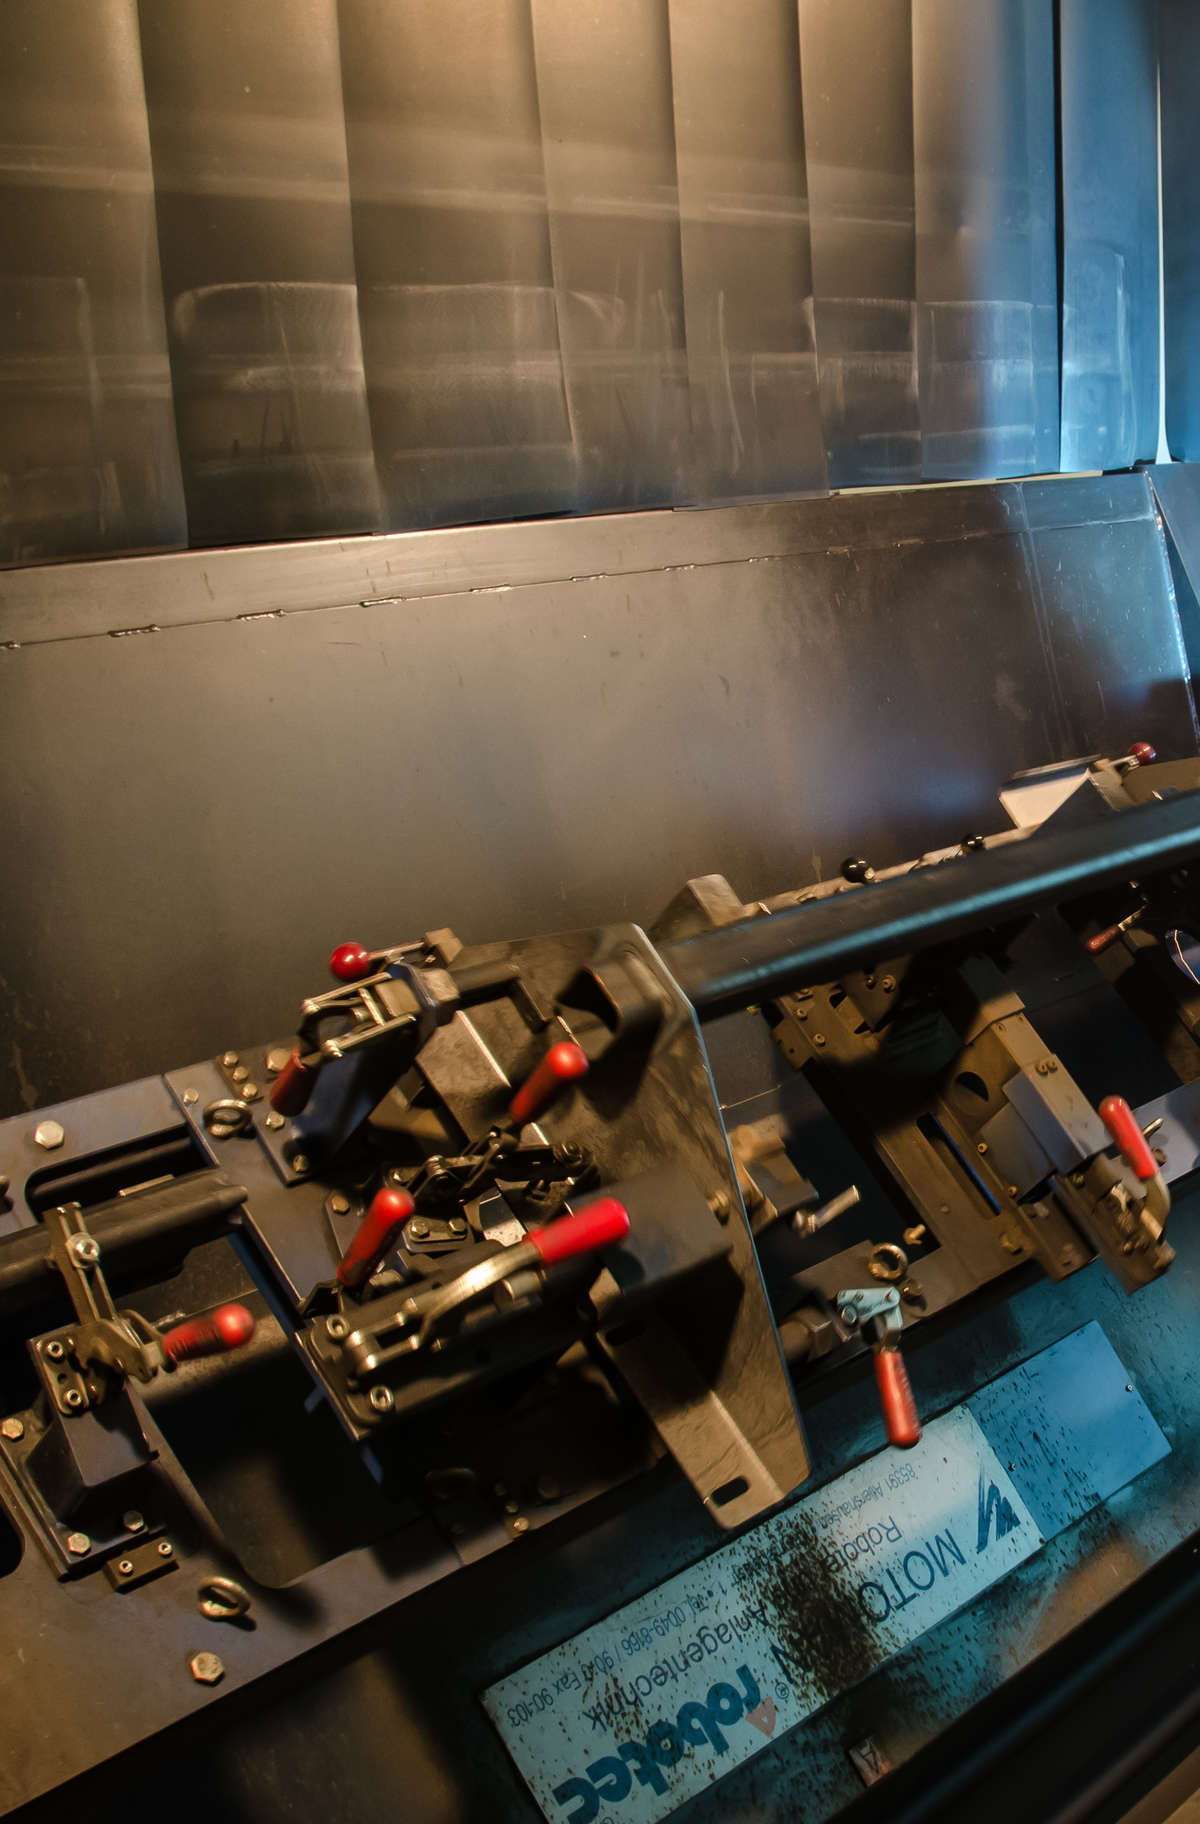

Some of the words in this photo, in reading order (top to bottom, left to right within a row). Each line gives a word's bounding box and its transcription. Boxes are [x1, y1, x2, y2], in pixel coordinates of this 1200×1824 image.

[884, 1462, 915, 1491] 85391
[620, 1606, 688, 1657] 0049-8166
[551, 1671, 581, 1699] Fax
[584, 1600, 773, 1733] Anlagentechnik
[506, 1687, 554, 1728] 90-103
[553, 1664, 761, 1824] robotec
